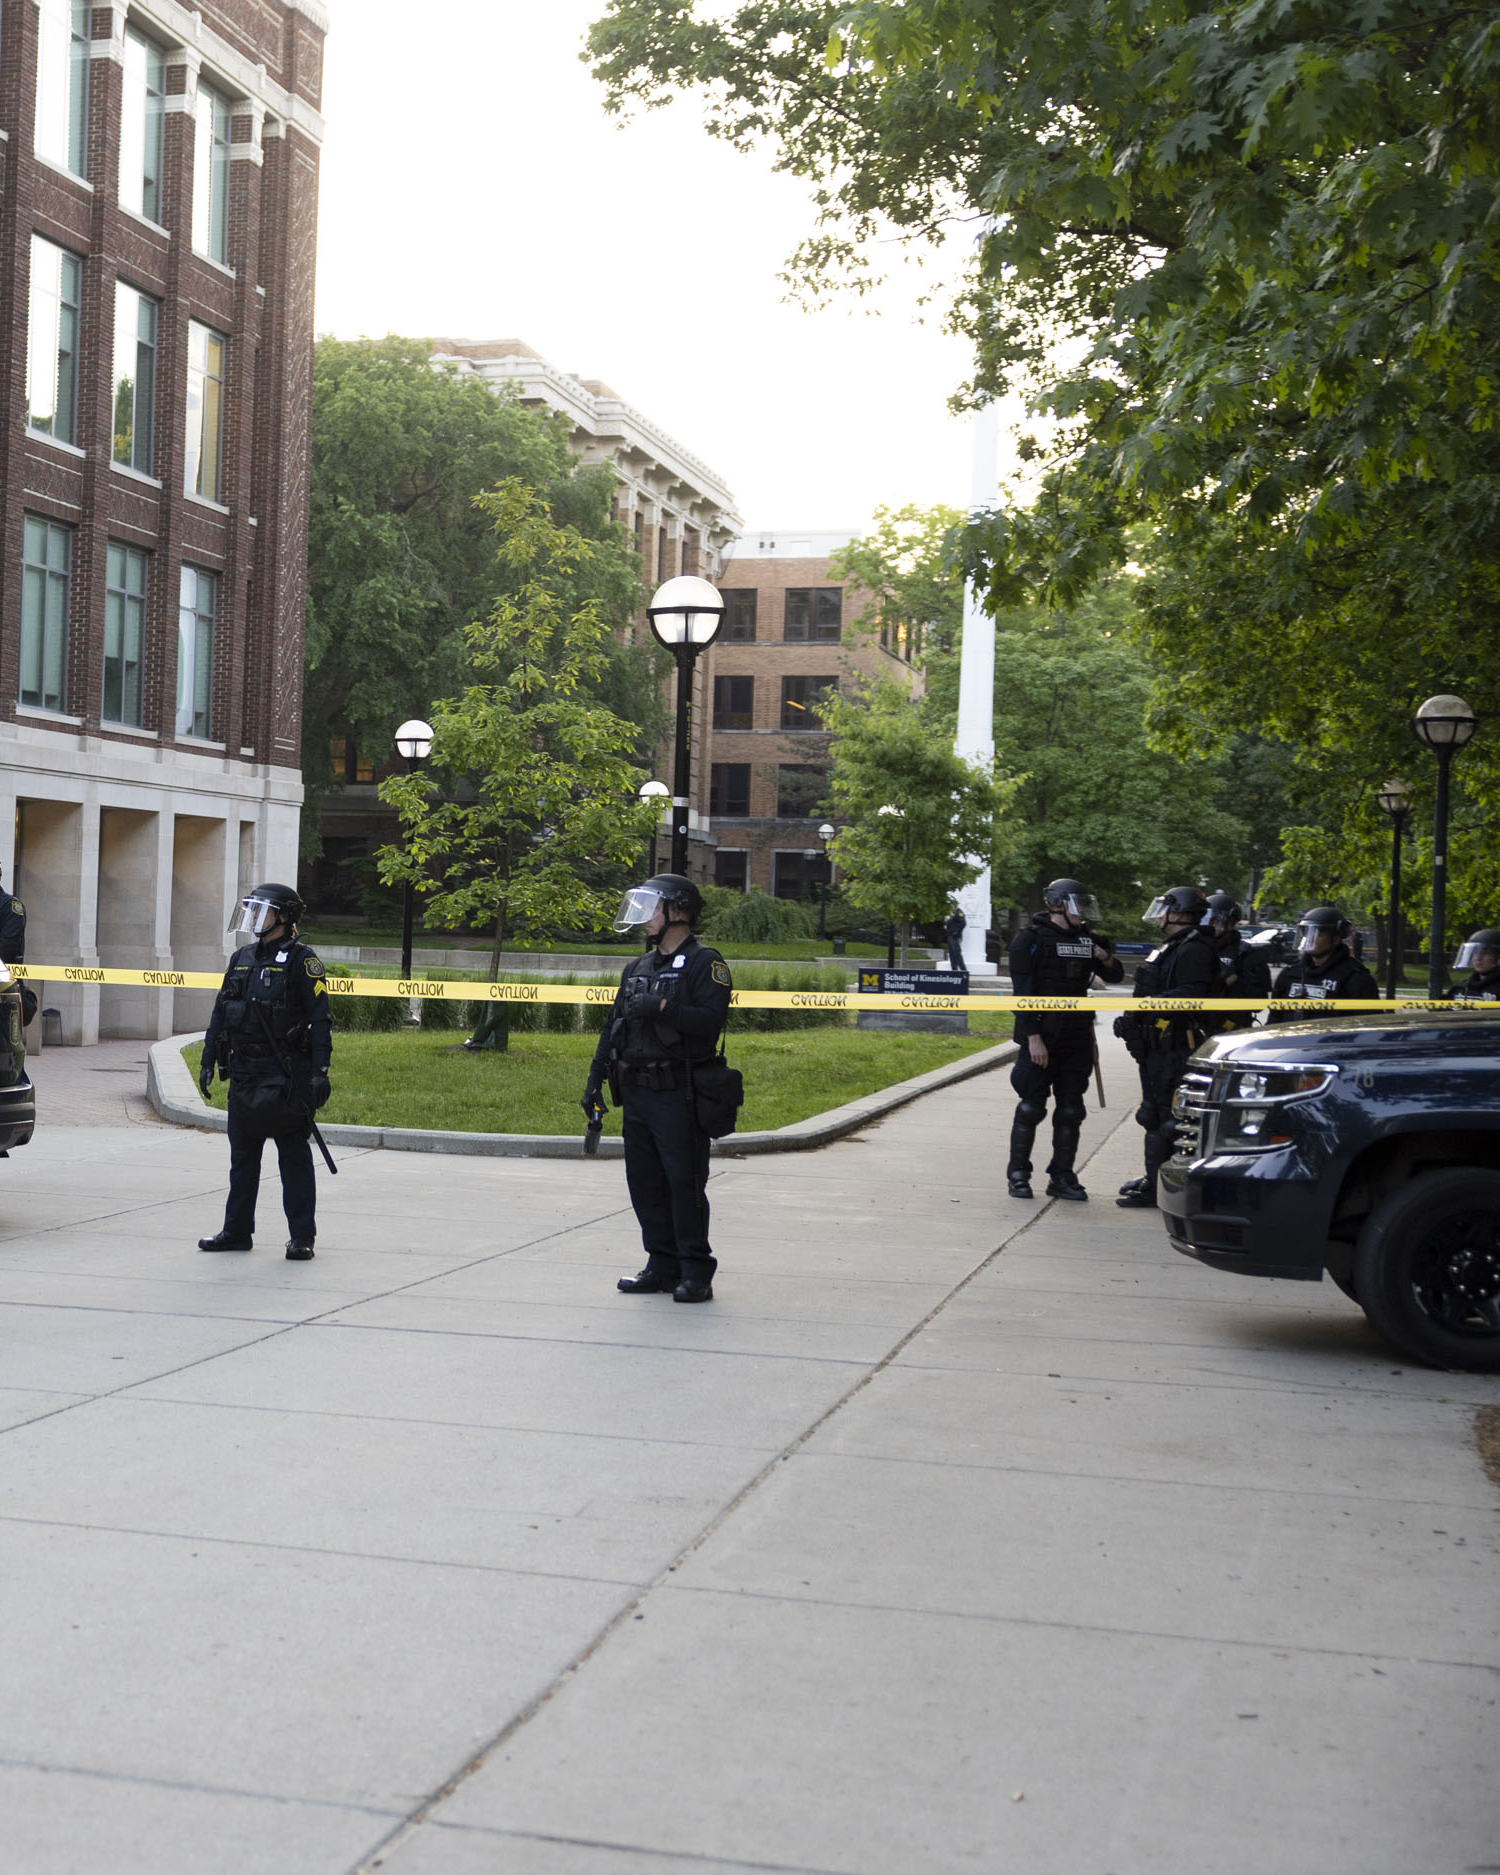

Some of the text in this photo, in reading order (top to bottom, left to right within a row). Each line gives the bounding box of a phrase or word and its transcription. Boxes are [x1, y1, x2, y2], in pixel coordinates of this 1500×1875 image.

[884, 973, 962, 985] School of Kinesiology
[1322, 979, 1337, 991] 121
[884, 981, 915, 991] Building
